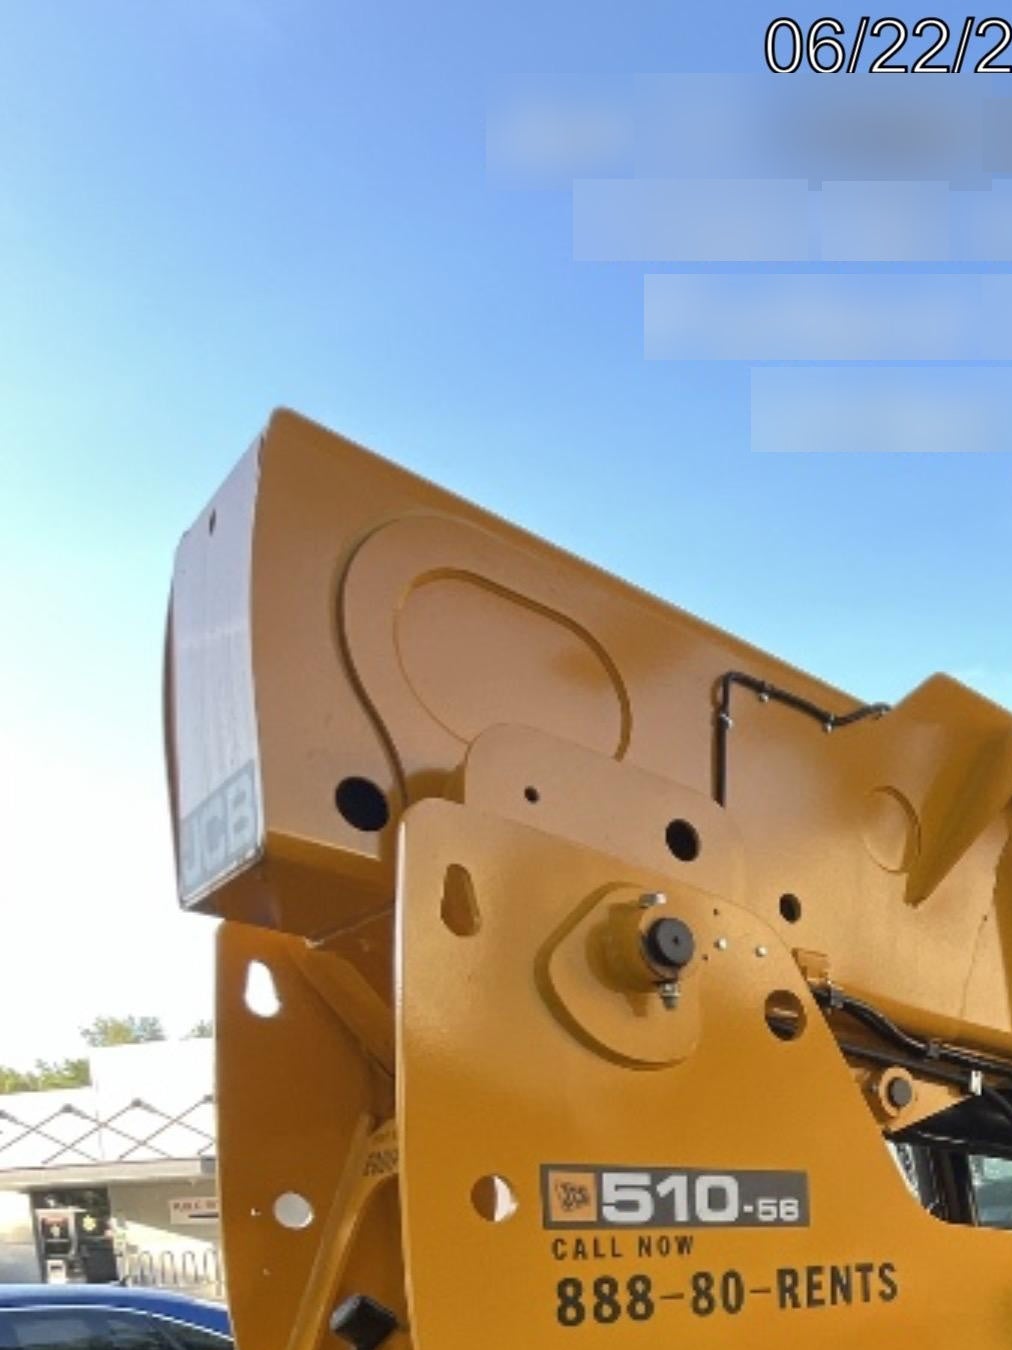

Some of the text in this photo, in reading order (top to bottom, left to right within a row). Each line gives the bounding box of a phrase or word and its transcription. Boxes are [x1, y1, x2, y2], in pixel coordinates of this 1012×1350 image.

[551, 1235, 694, 1261] CALL NOW
[556, 1262, 899, 1327] 888-80-RENTS
